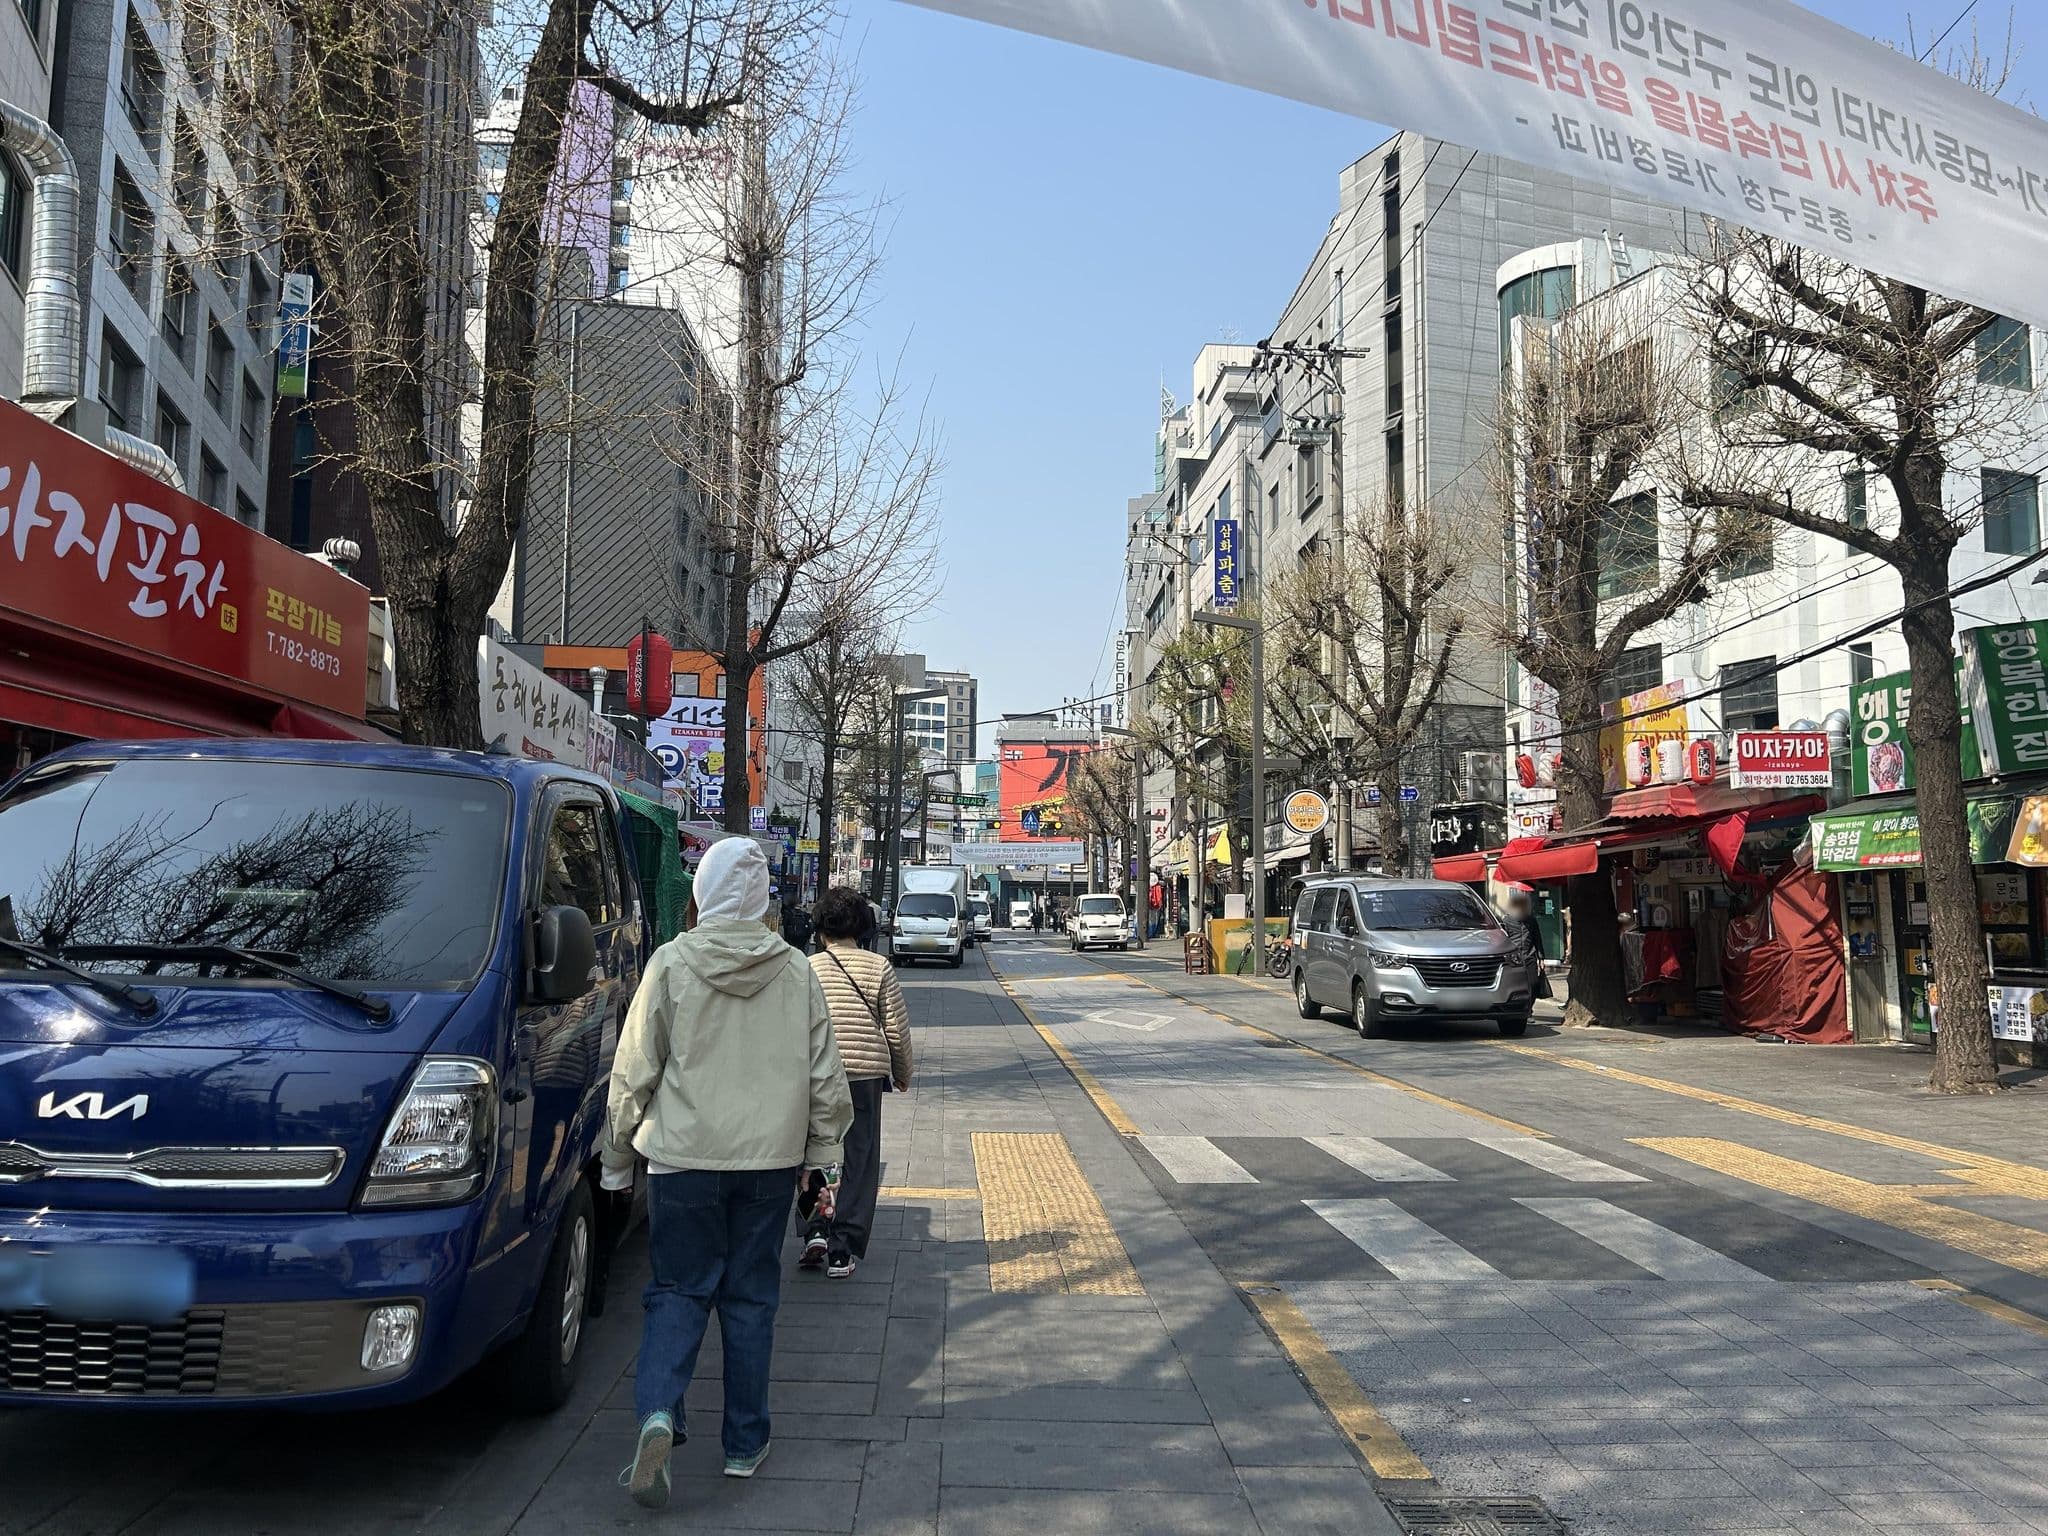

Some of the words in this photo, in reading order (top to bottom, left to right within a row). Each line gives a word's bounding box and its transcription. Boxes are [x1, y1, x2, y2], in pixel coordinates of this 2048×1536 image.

[1217, 523, 1236, 594] 삼화파출
[266, 587, 342, 647] 포장가능
[267, 631, 341, 677] T.782-8873
[491, 655, 577, 748] 동해남부선
[1741, 738, 1824, 758] 이자카야
[1785, 775, 1828, 785] 02.765.3684
[1873, 820, 1880, 832] 이
[1882, 817, 1899, 832] 맛이
[1825, 831, 1860, 847] 송명섭
[1822, 847, 1857, 862] 막걸리
[38, 1091, 149, 1121] KIA
